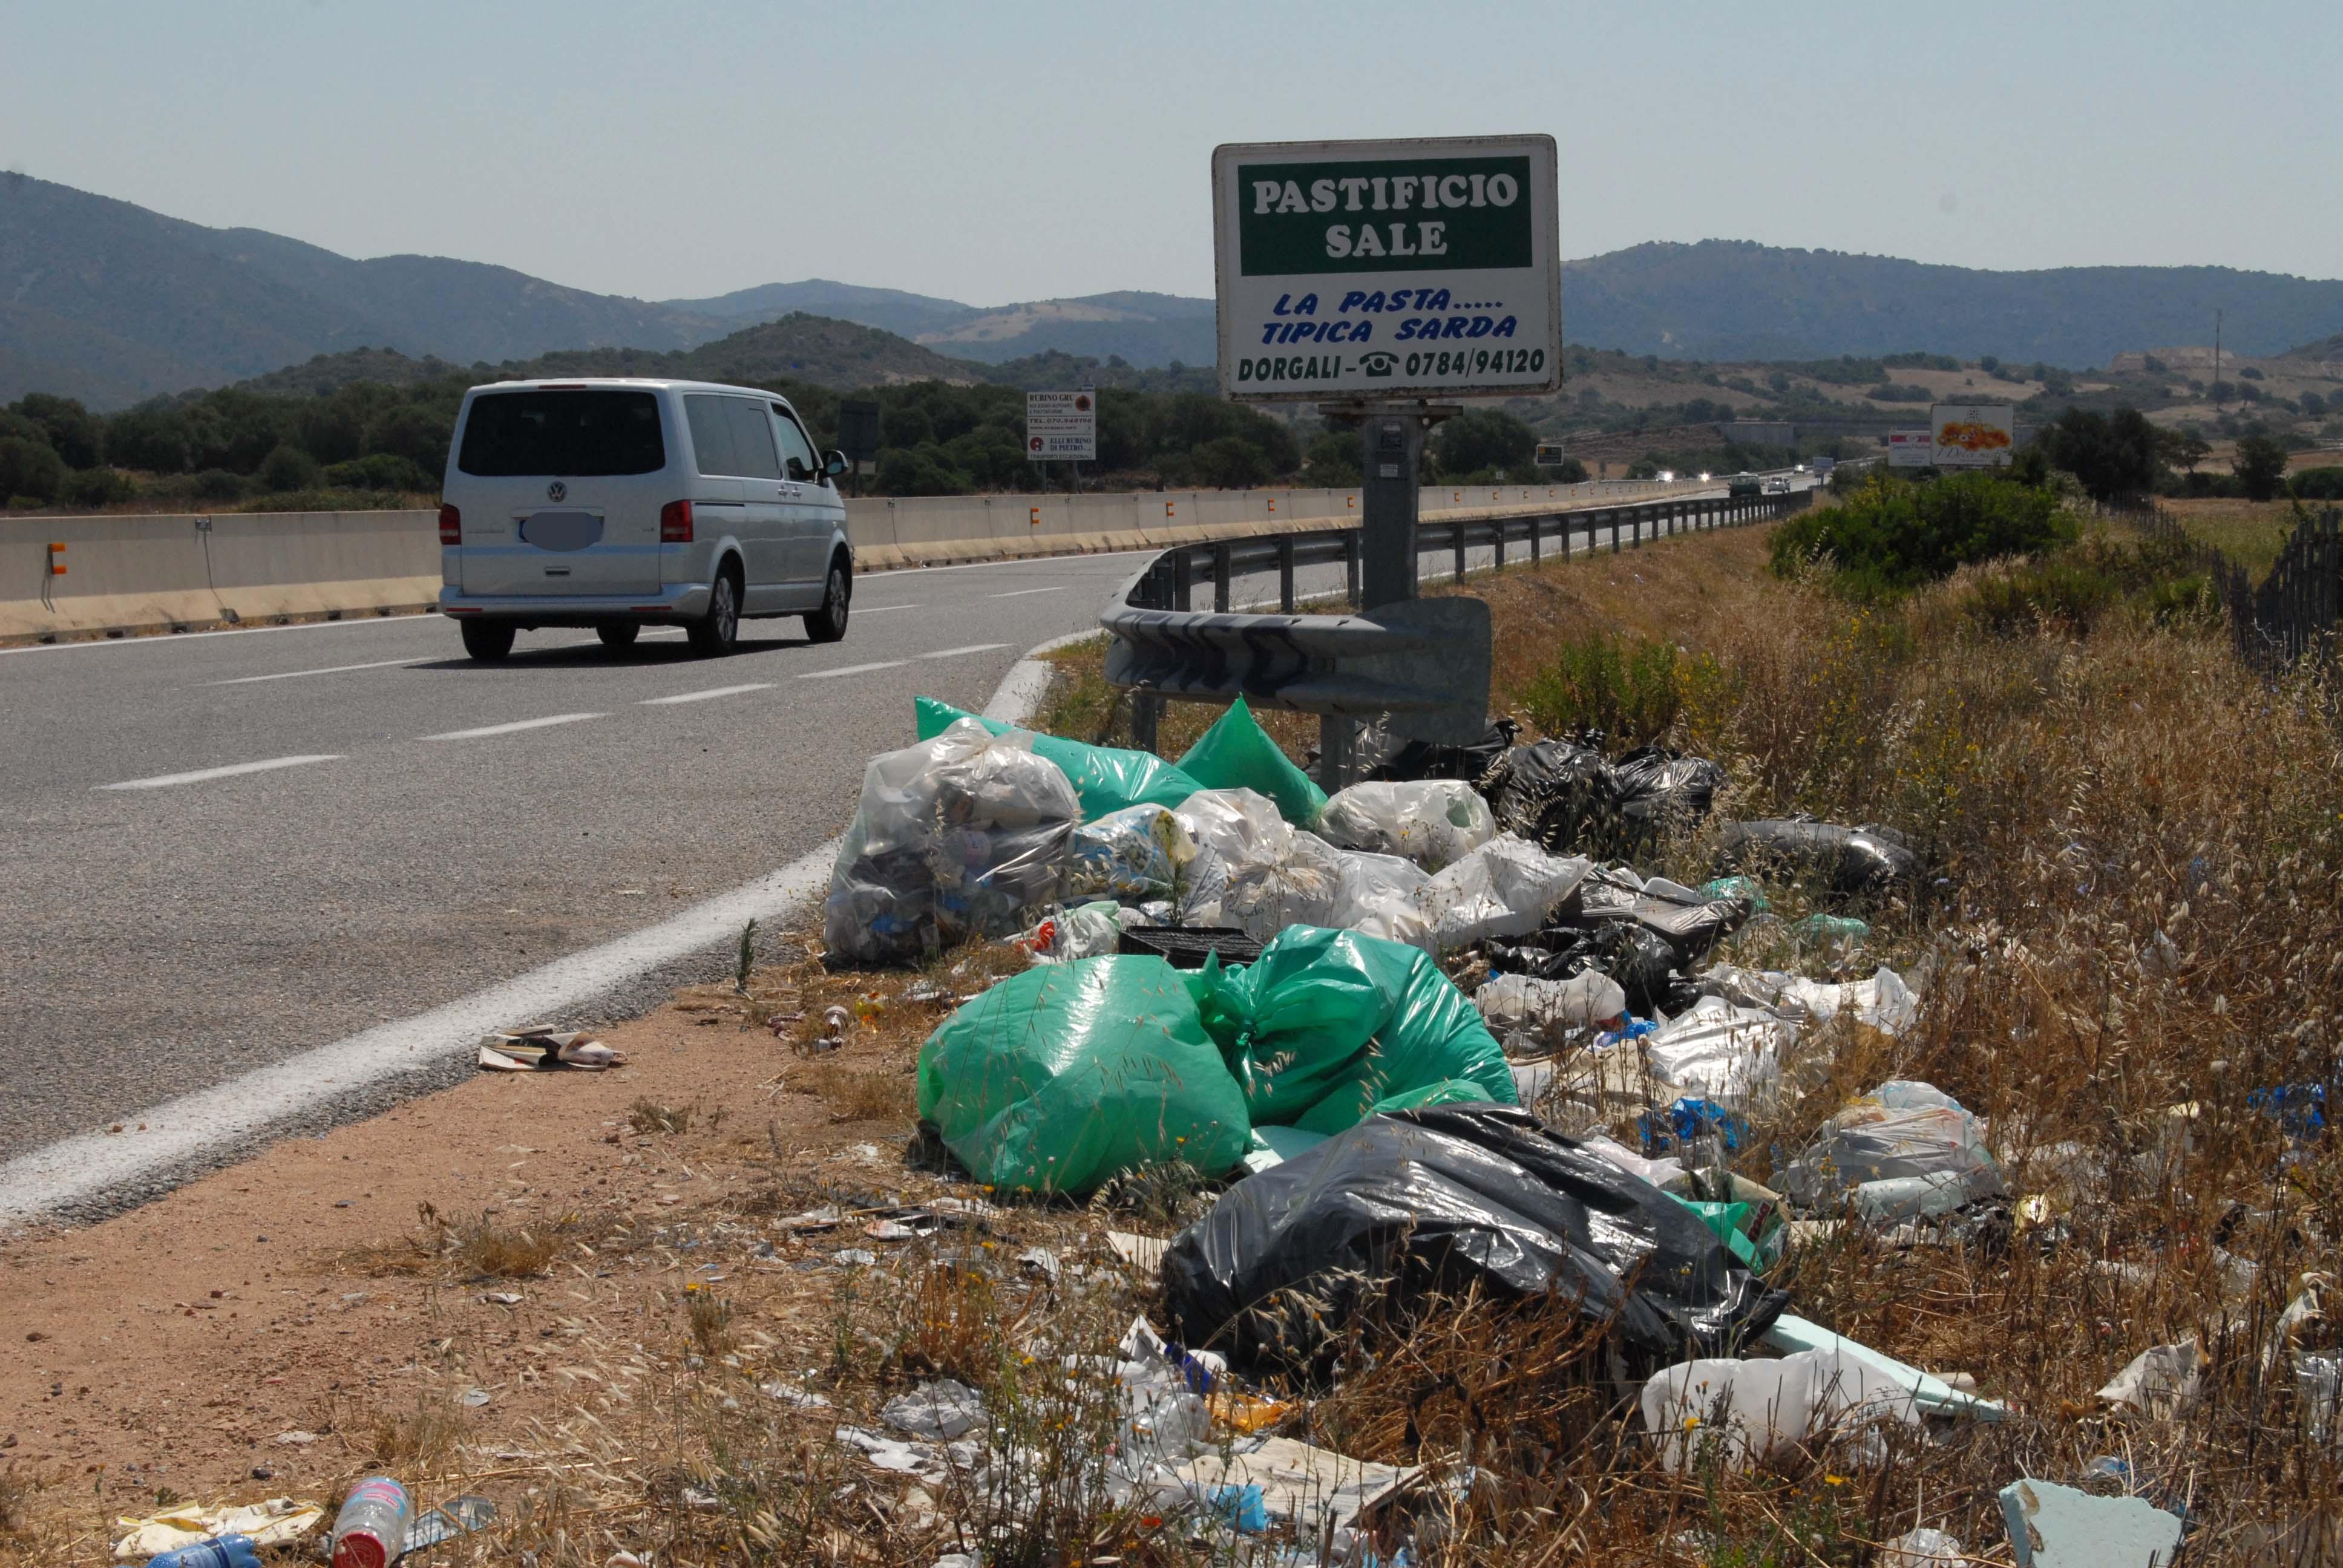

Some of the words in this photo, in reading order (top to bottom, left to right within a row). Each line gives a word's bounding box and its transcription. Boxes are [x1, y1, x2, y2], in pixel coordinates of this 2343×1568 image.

[1252, 173, 1518, 214] PASTIFICIO
[1325, 221, 1447, 258] SALE
[1273, 293, 1319, 316] LA
[1261, 321, 1372, 345] TIPICA
[1394, 315, 1518, 341] SARDA
[1406, 348, 1545, 379] 0784/94120
